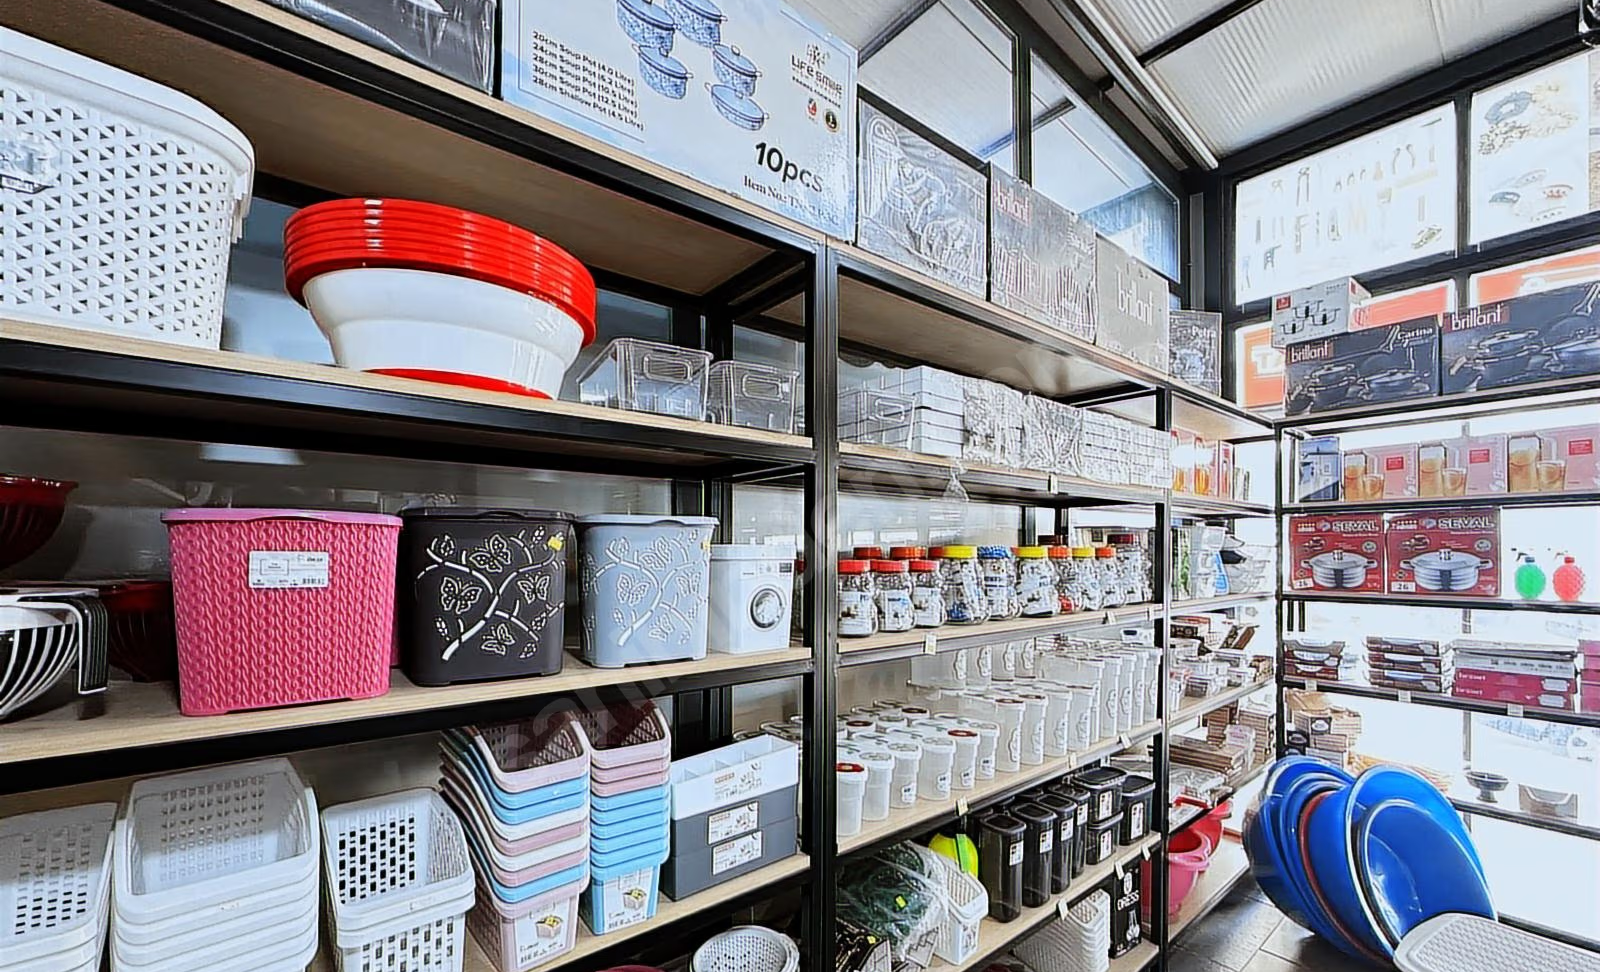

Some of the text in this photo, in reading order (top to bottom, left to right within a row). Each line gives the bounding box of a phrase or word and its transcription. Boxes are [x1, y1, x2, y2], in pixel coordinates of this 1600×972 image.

[755, 142, 824, 193] 10pcs
[1452, 304, 1502, 331] brillant
[1290, 340, 1329, 363] brillant
[1332, 519, 1380, 533] SEVAL
[1438, 516, 1495, 529] SEVAL
